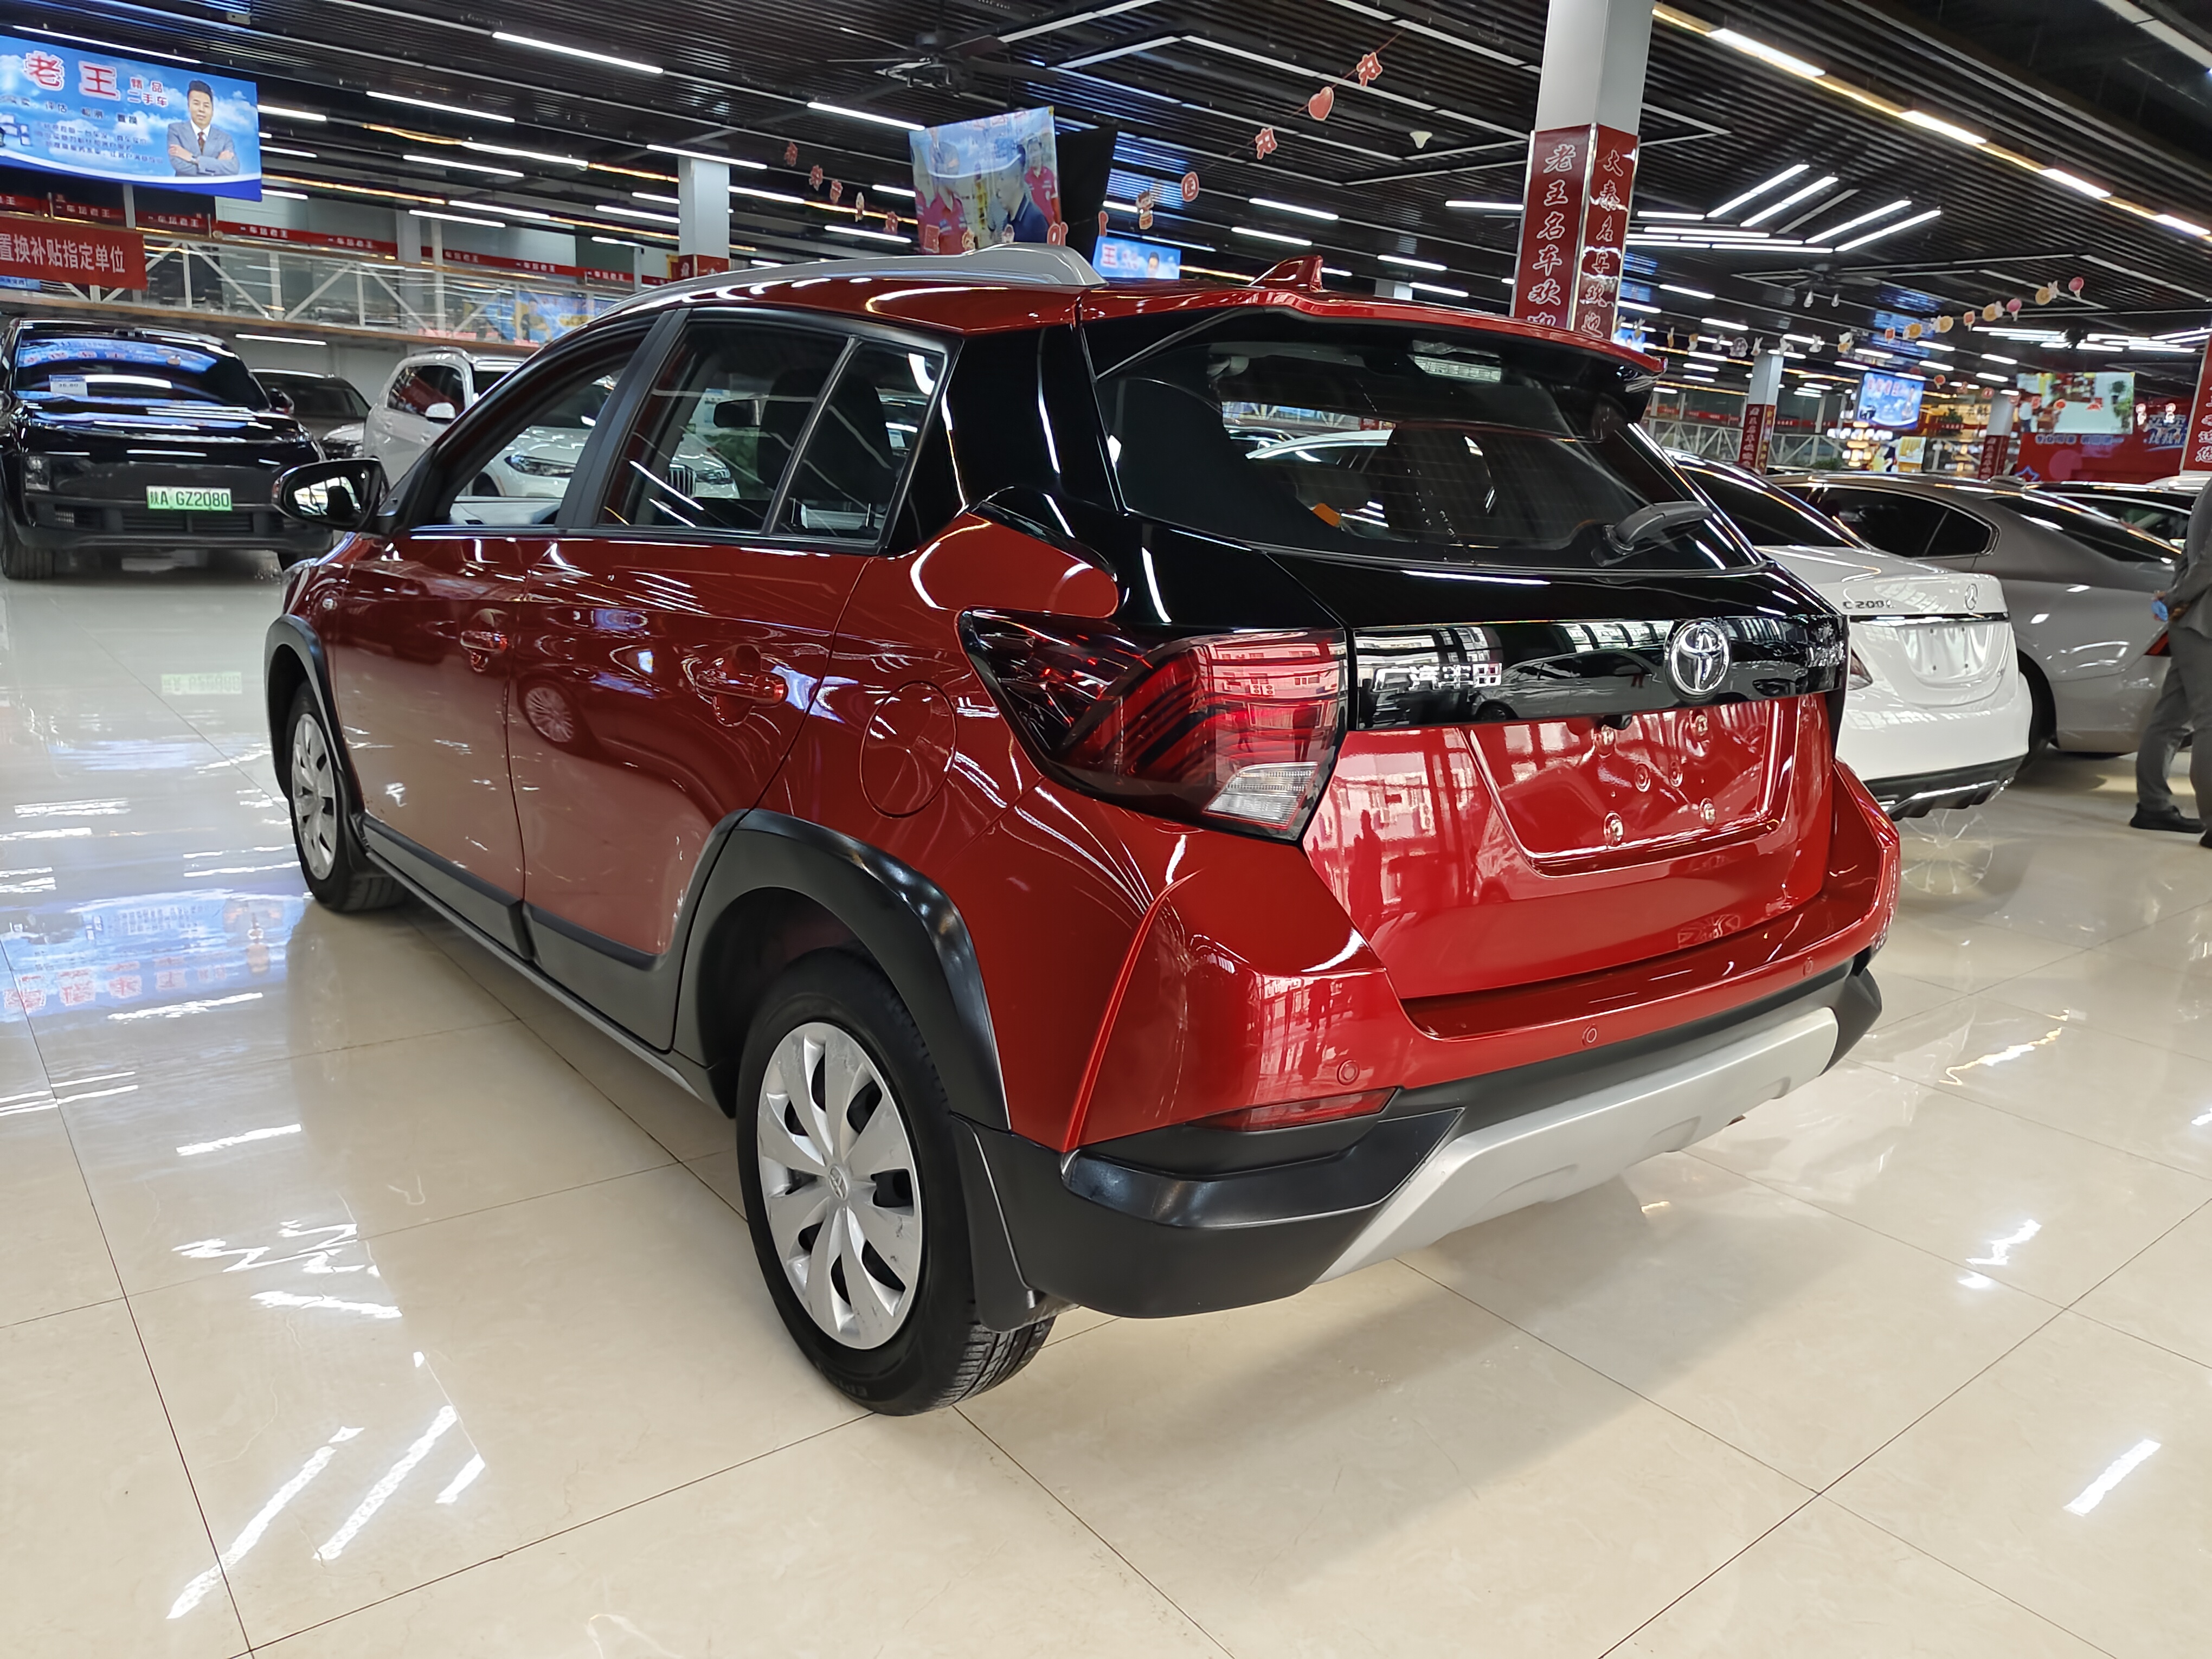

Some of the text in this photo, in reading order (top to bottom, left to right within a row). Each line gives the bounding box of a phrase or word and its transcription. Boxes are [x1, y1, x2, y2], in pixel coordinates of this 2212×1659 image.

[25, 52, 119, 100] 老王
[128, 90, 168, 107] 二手车
[0, 233, 125, 273] 置换补贴指定单位
[176, 492, 229, 507] GZ2080
